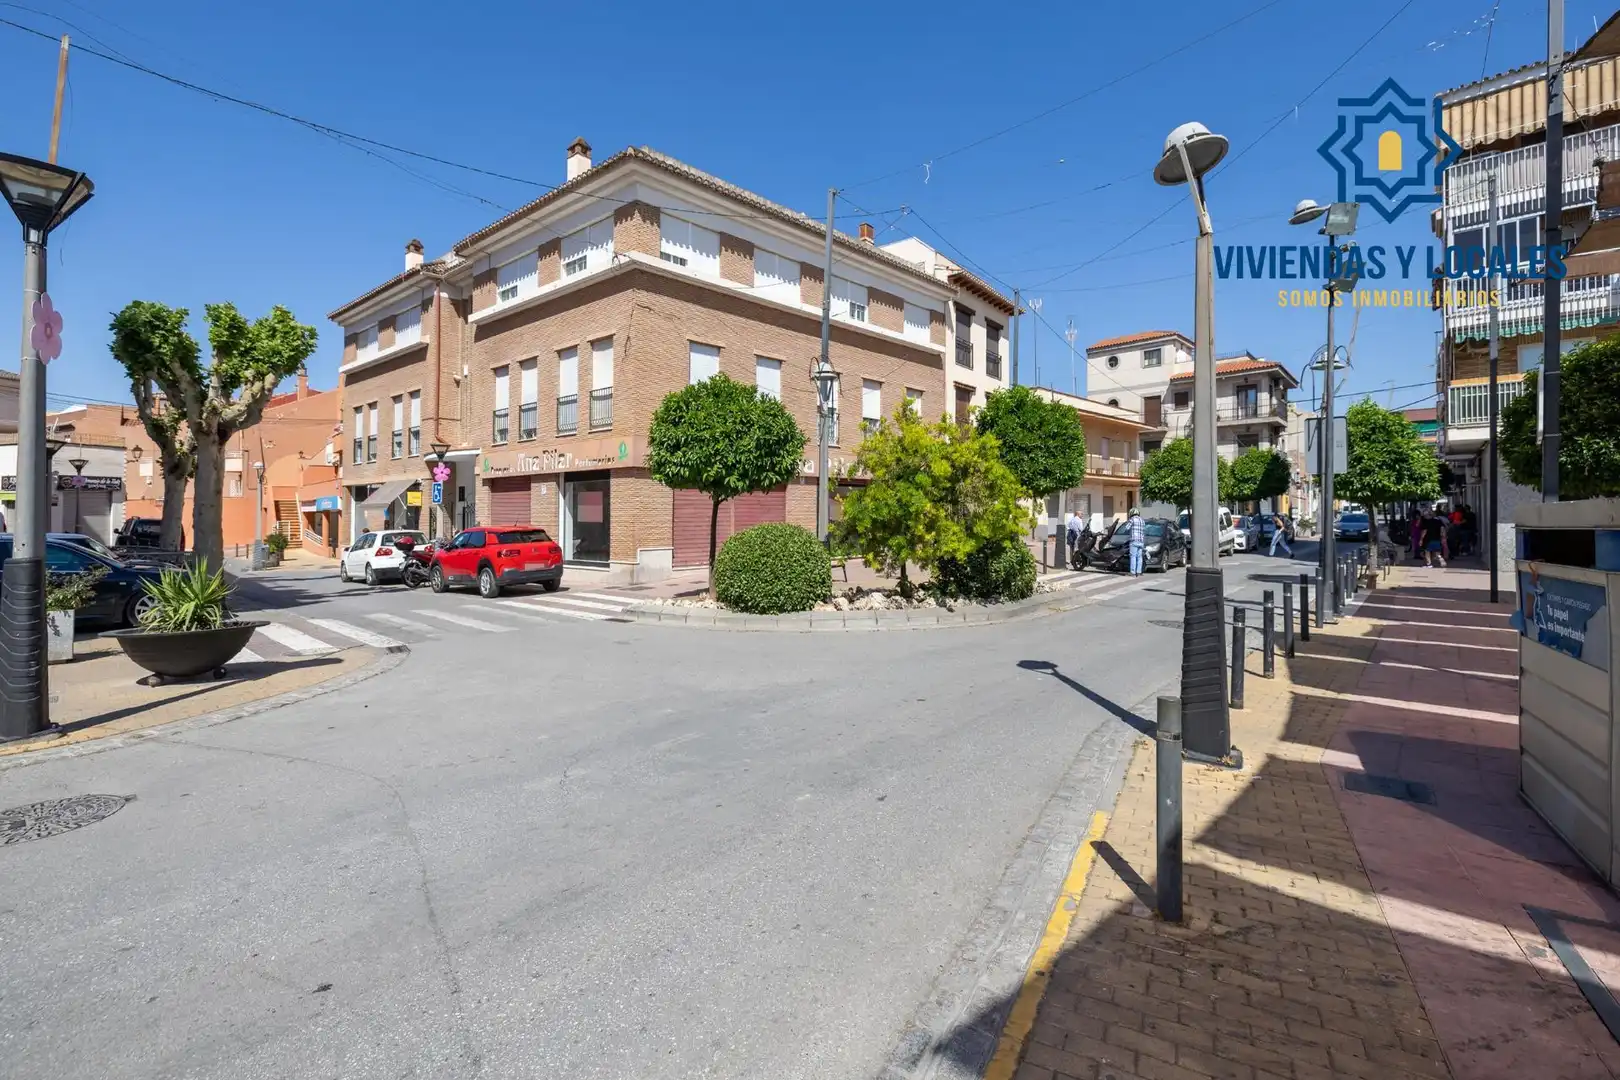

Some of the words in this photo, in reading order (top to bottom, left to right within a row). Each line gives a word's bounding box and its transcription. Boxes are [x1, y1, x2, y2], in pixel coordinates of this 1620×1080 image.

[517, 453, 540, 472] Ana
[543, 448, 573, 471] Pilar
[1554, 608, 1569, 621] papel
[1547, 621, 1554, 631] es
[1554, 621, 1585, 641] importante
